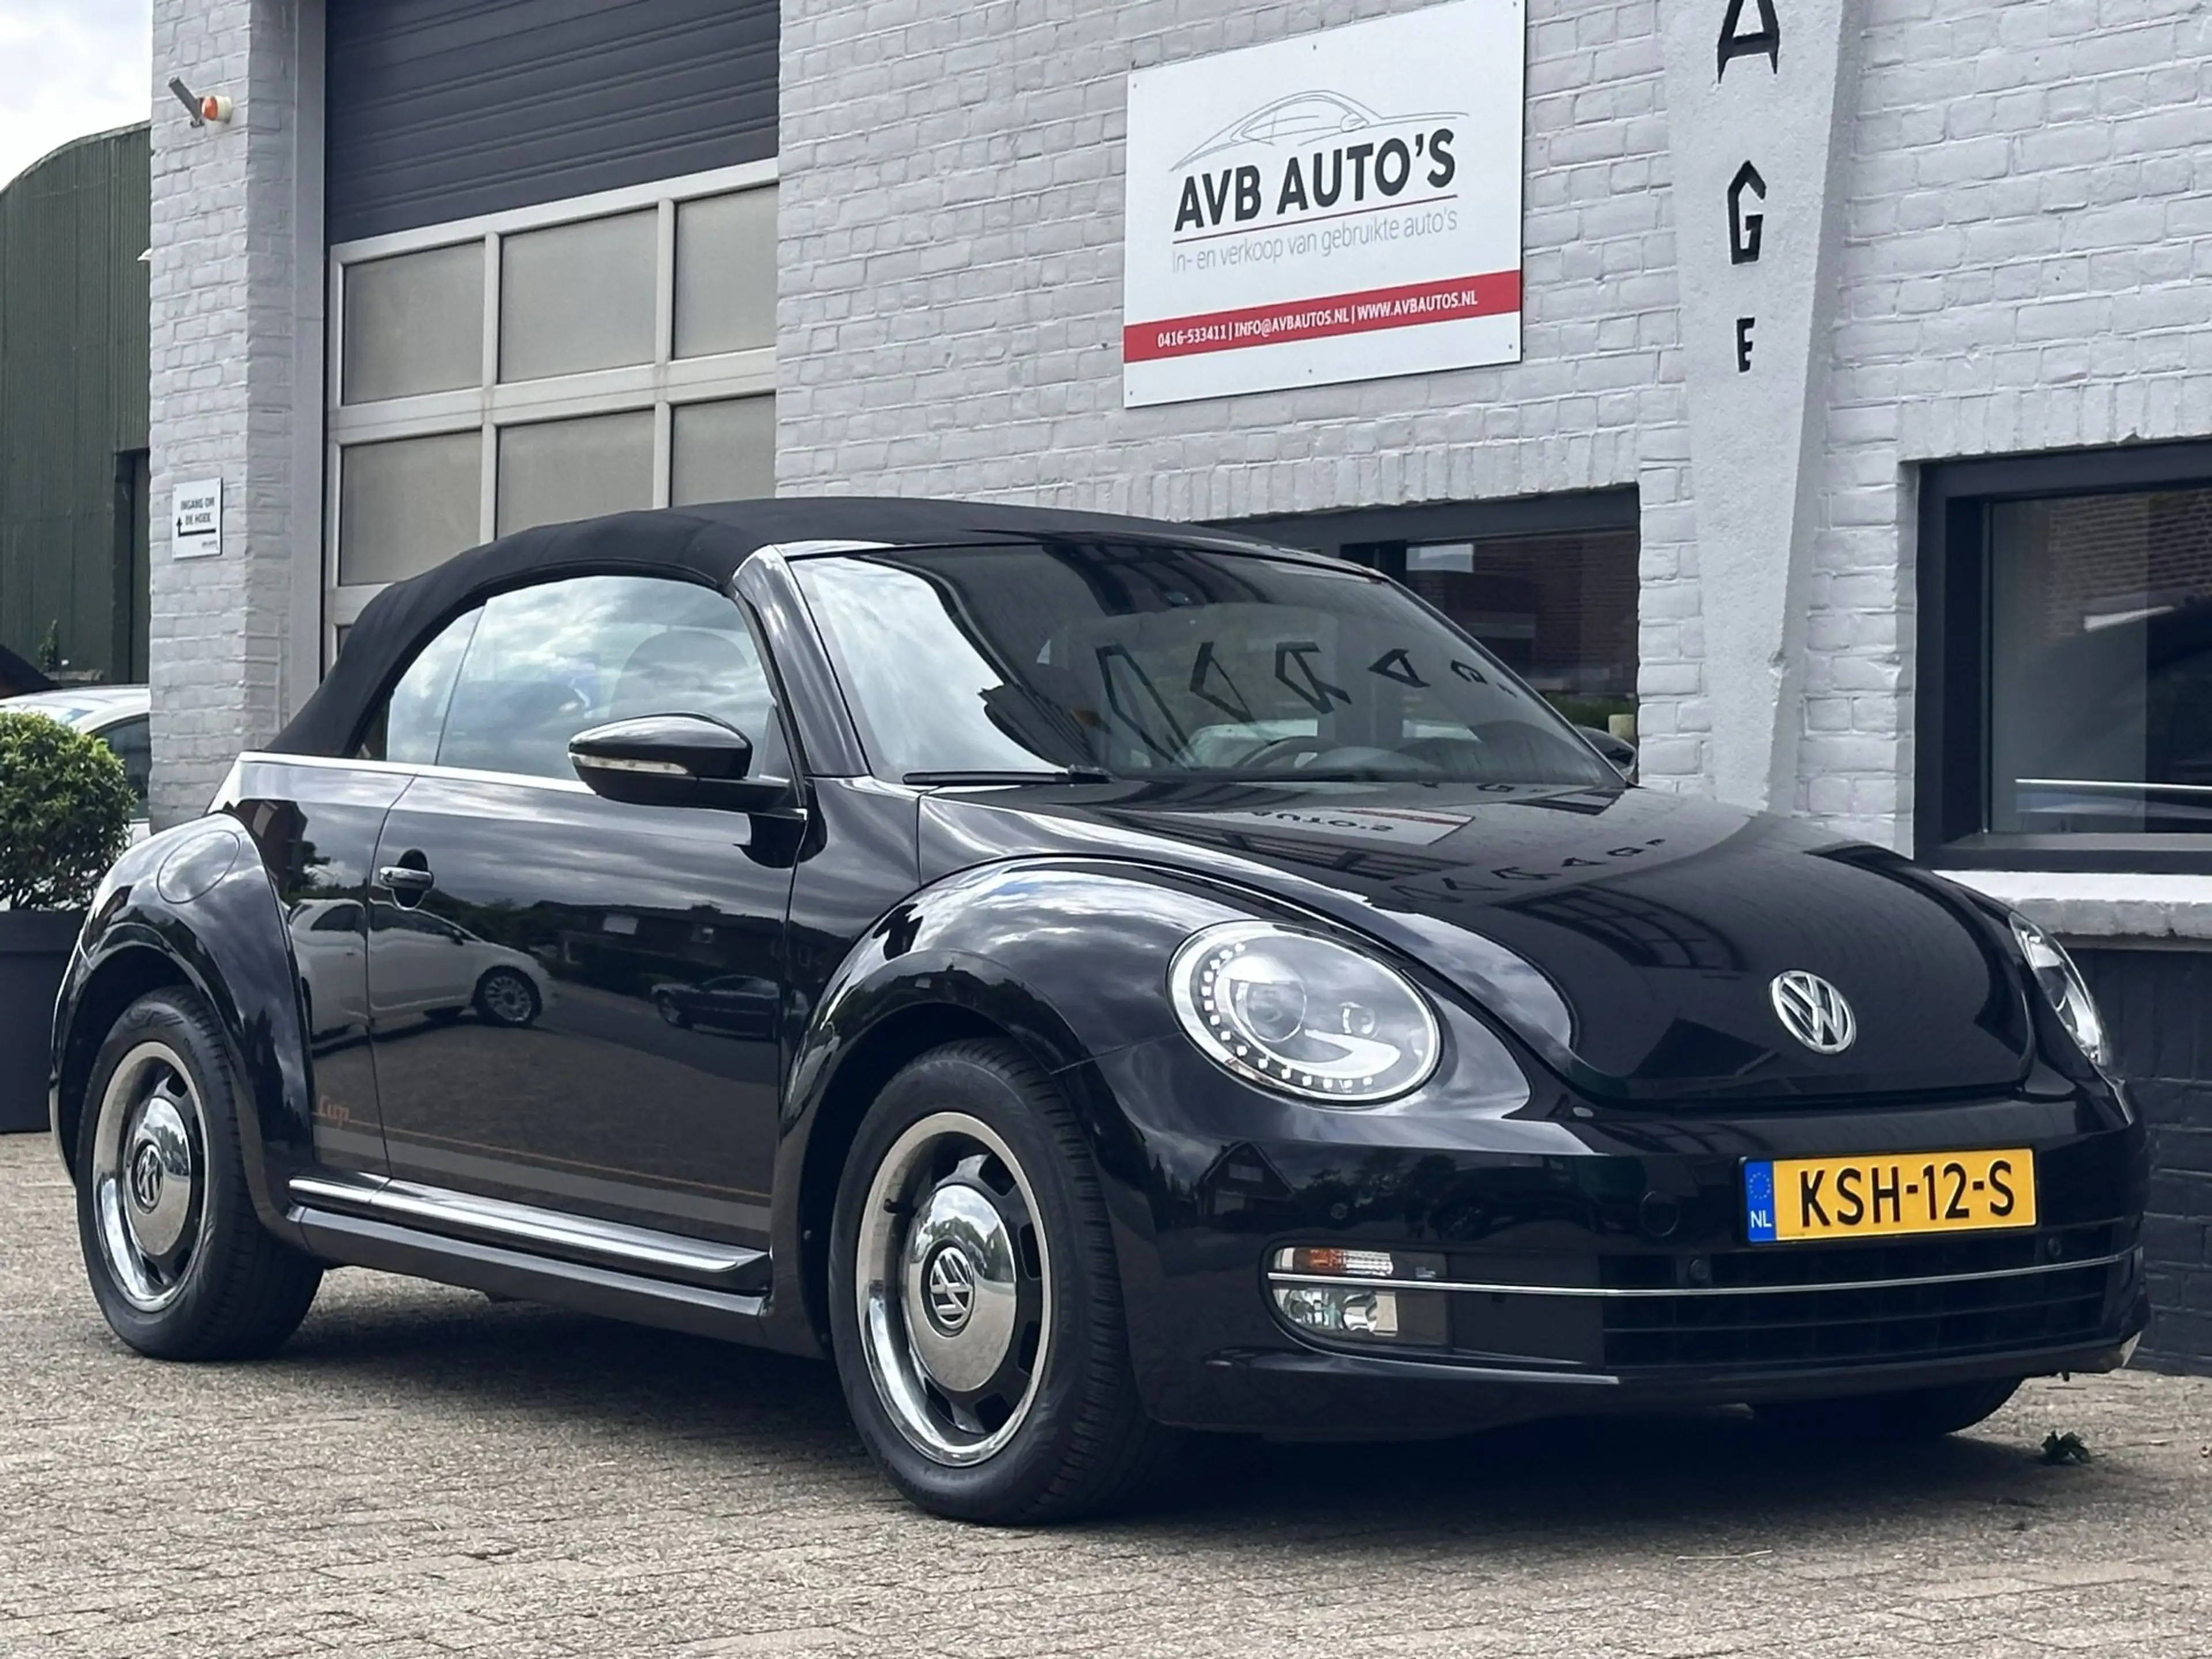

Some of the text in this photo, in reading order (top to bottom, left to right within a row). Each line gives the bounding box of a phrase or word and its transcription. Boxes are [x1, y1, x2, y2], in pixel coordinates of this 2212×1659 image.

[1173, 128, 1456, 232] AVB AUTO'S
[1197, 248, 1216, 270] en
[1219, 236, 1283, 266] verkoop
[1288, 233, 1317, 256] van
[1322, 218, 1400, 257] gebruikte
[1404, 210, 1459, 237] auto's
[1157, 290, 1478, 349] 0416-533411 INFO@AVBAUTOS.NL WWW.AVBAUTOS.NL
[1750, 1210, 1772, 1229] NL
[1800, 1159, 2015, 1228] KSH-12-S
